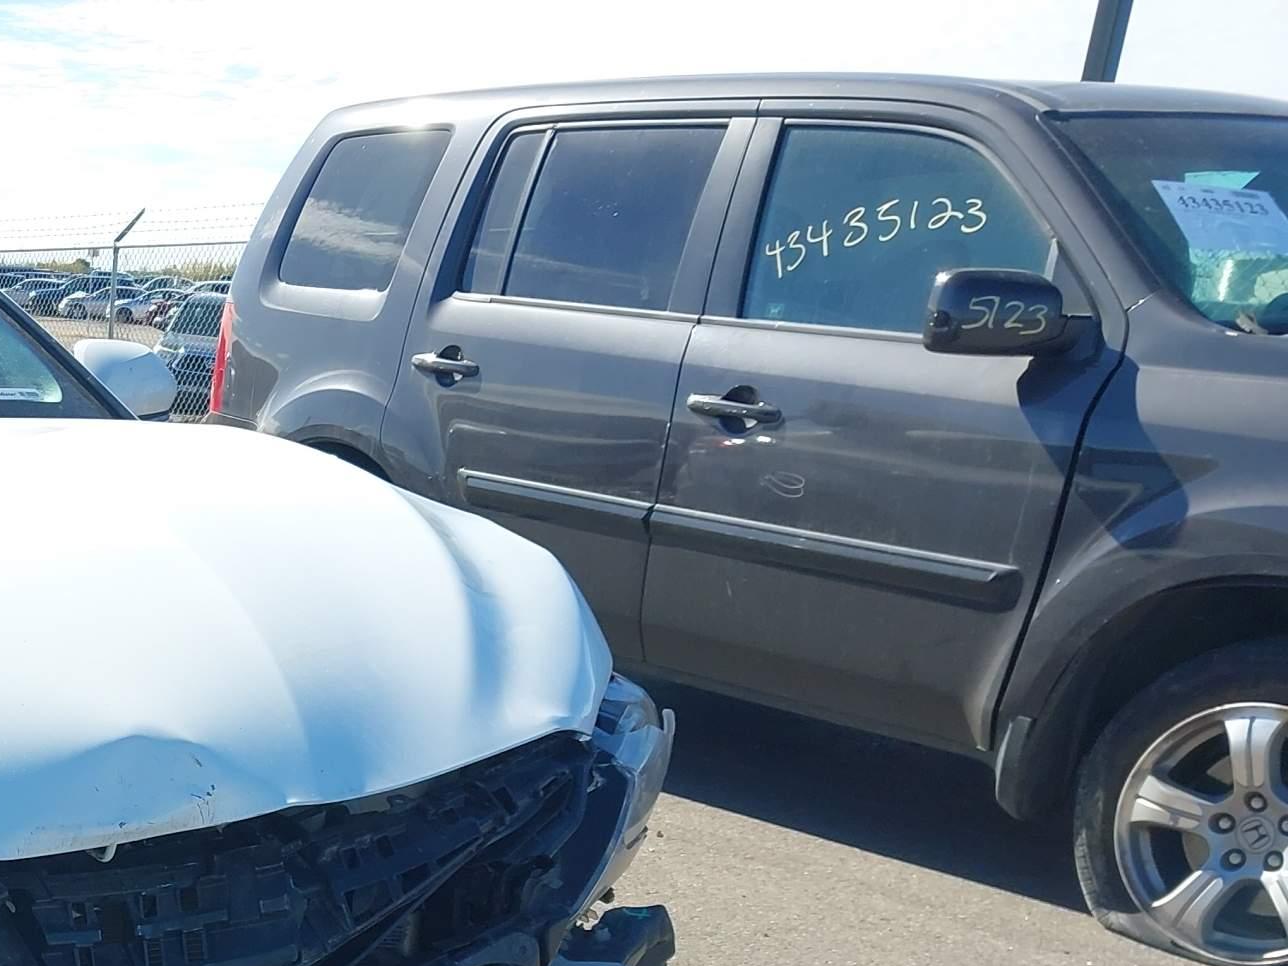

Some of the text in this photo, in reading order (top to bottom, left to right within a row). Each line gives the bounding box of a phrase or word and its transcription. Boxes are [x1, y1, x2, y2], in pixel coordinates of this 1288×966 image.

[1177, 196, 1269, 216] 43435123
[765, 198, 987, 279] 43435123
[961, 296, 1049, 335] 5123
